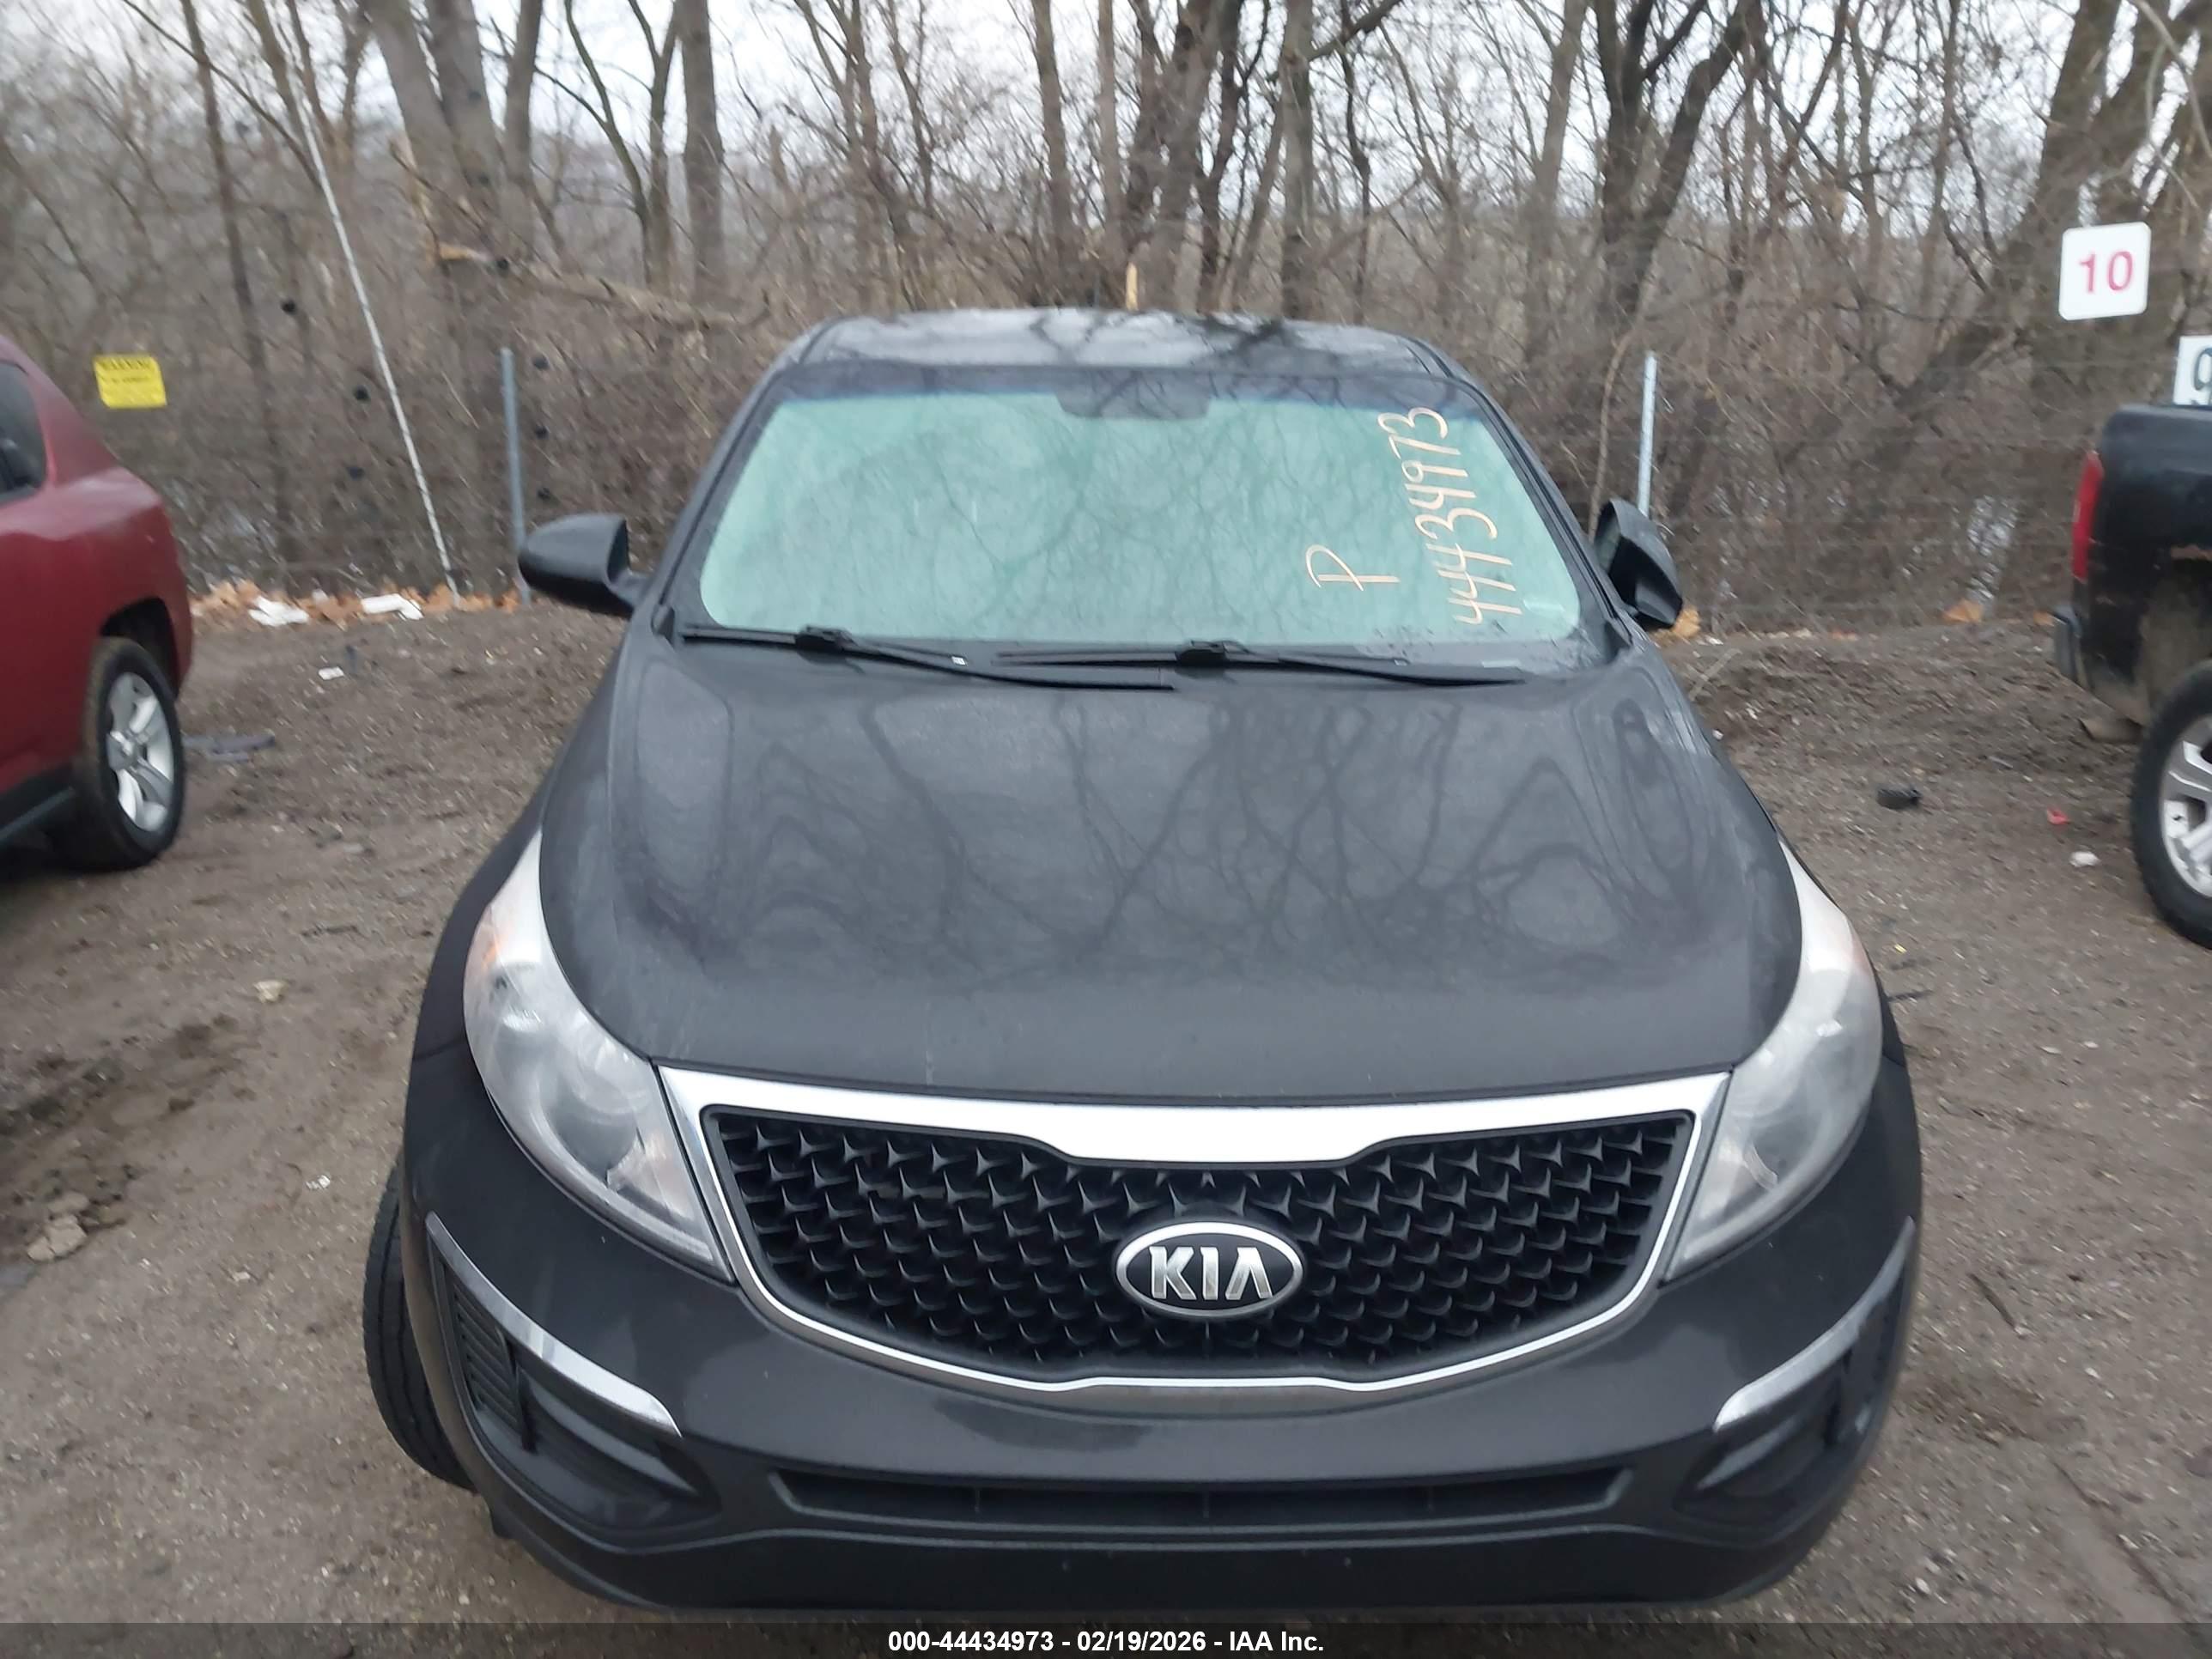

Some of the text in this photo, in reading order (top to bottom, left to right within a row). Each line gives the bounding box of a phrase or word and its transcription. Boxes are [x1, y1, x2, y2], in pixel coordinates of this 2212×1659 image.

[2079, 251, 2134, 293] 10
[1377, 407, 1522, 625] 44434973
[1305, 544, 1401, 592] P
[1149, 1246, 1273, 1300] KIA
